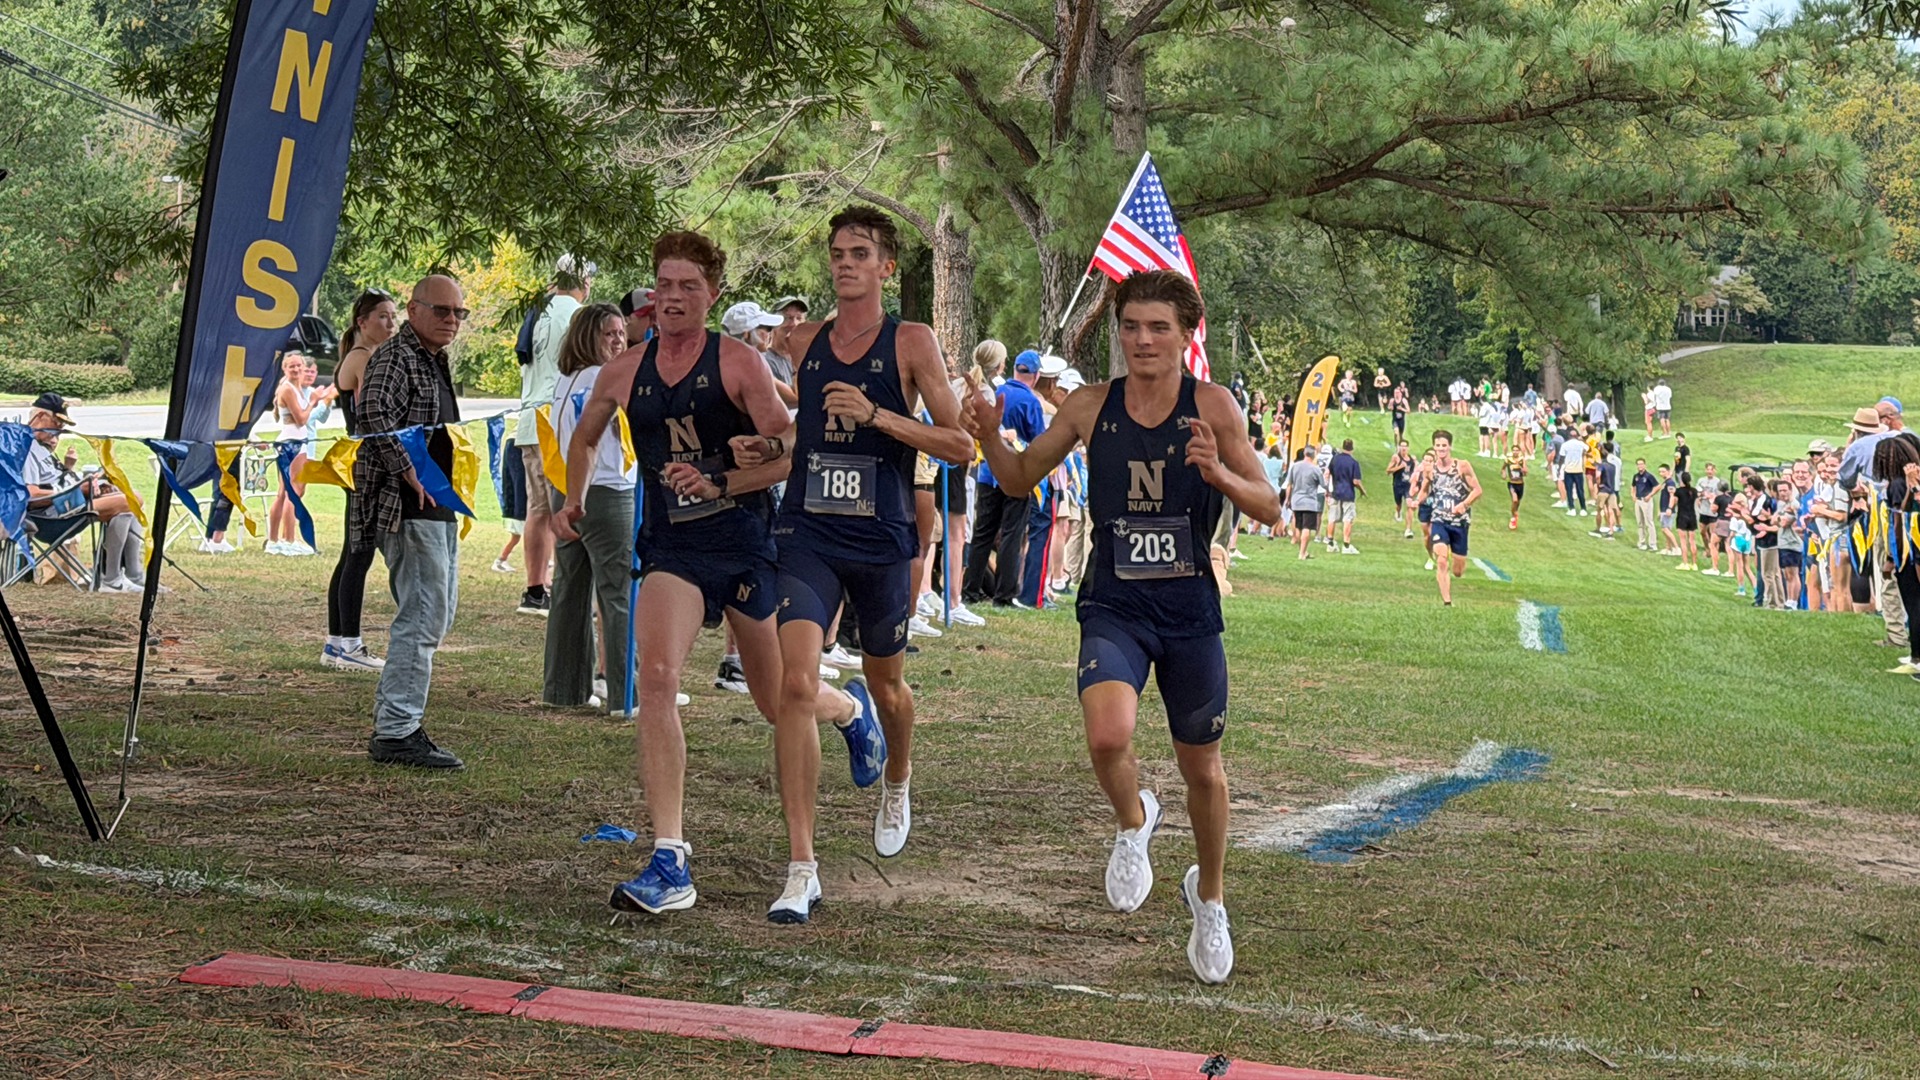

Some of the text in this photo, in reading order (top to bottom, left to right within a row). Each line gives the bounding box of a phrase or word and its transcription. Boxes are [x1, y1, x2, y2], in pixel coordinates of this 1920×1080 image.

[218, 0, 333, 430] NISH
[1311, 372, 1325, 388] 2
[665, 415, 702, 452] N
[824, 432, 856, 443] NAVY
[821, 469, 861, 499] 188
[1128, 460, 1166, 500] N
[1127, 500, 1164, 513] NAVY
[1129, 533, 1177, 562] 203
[736, 583, 751, 602] N
